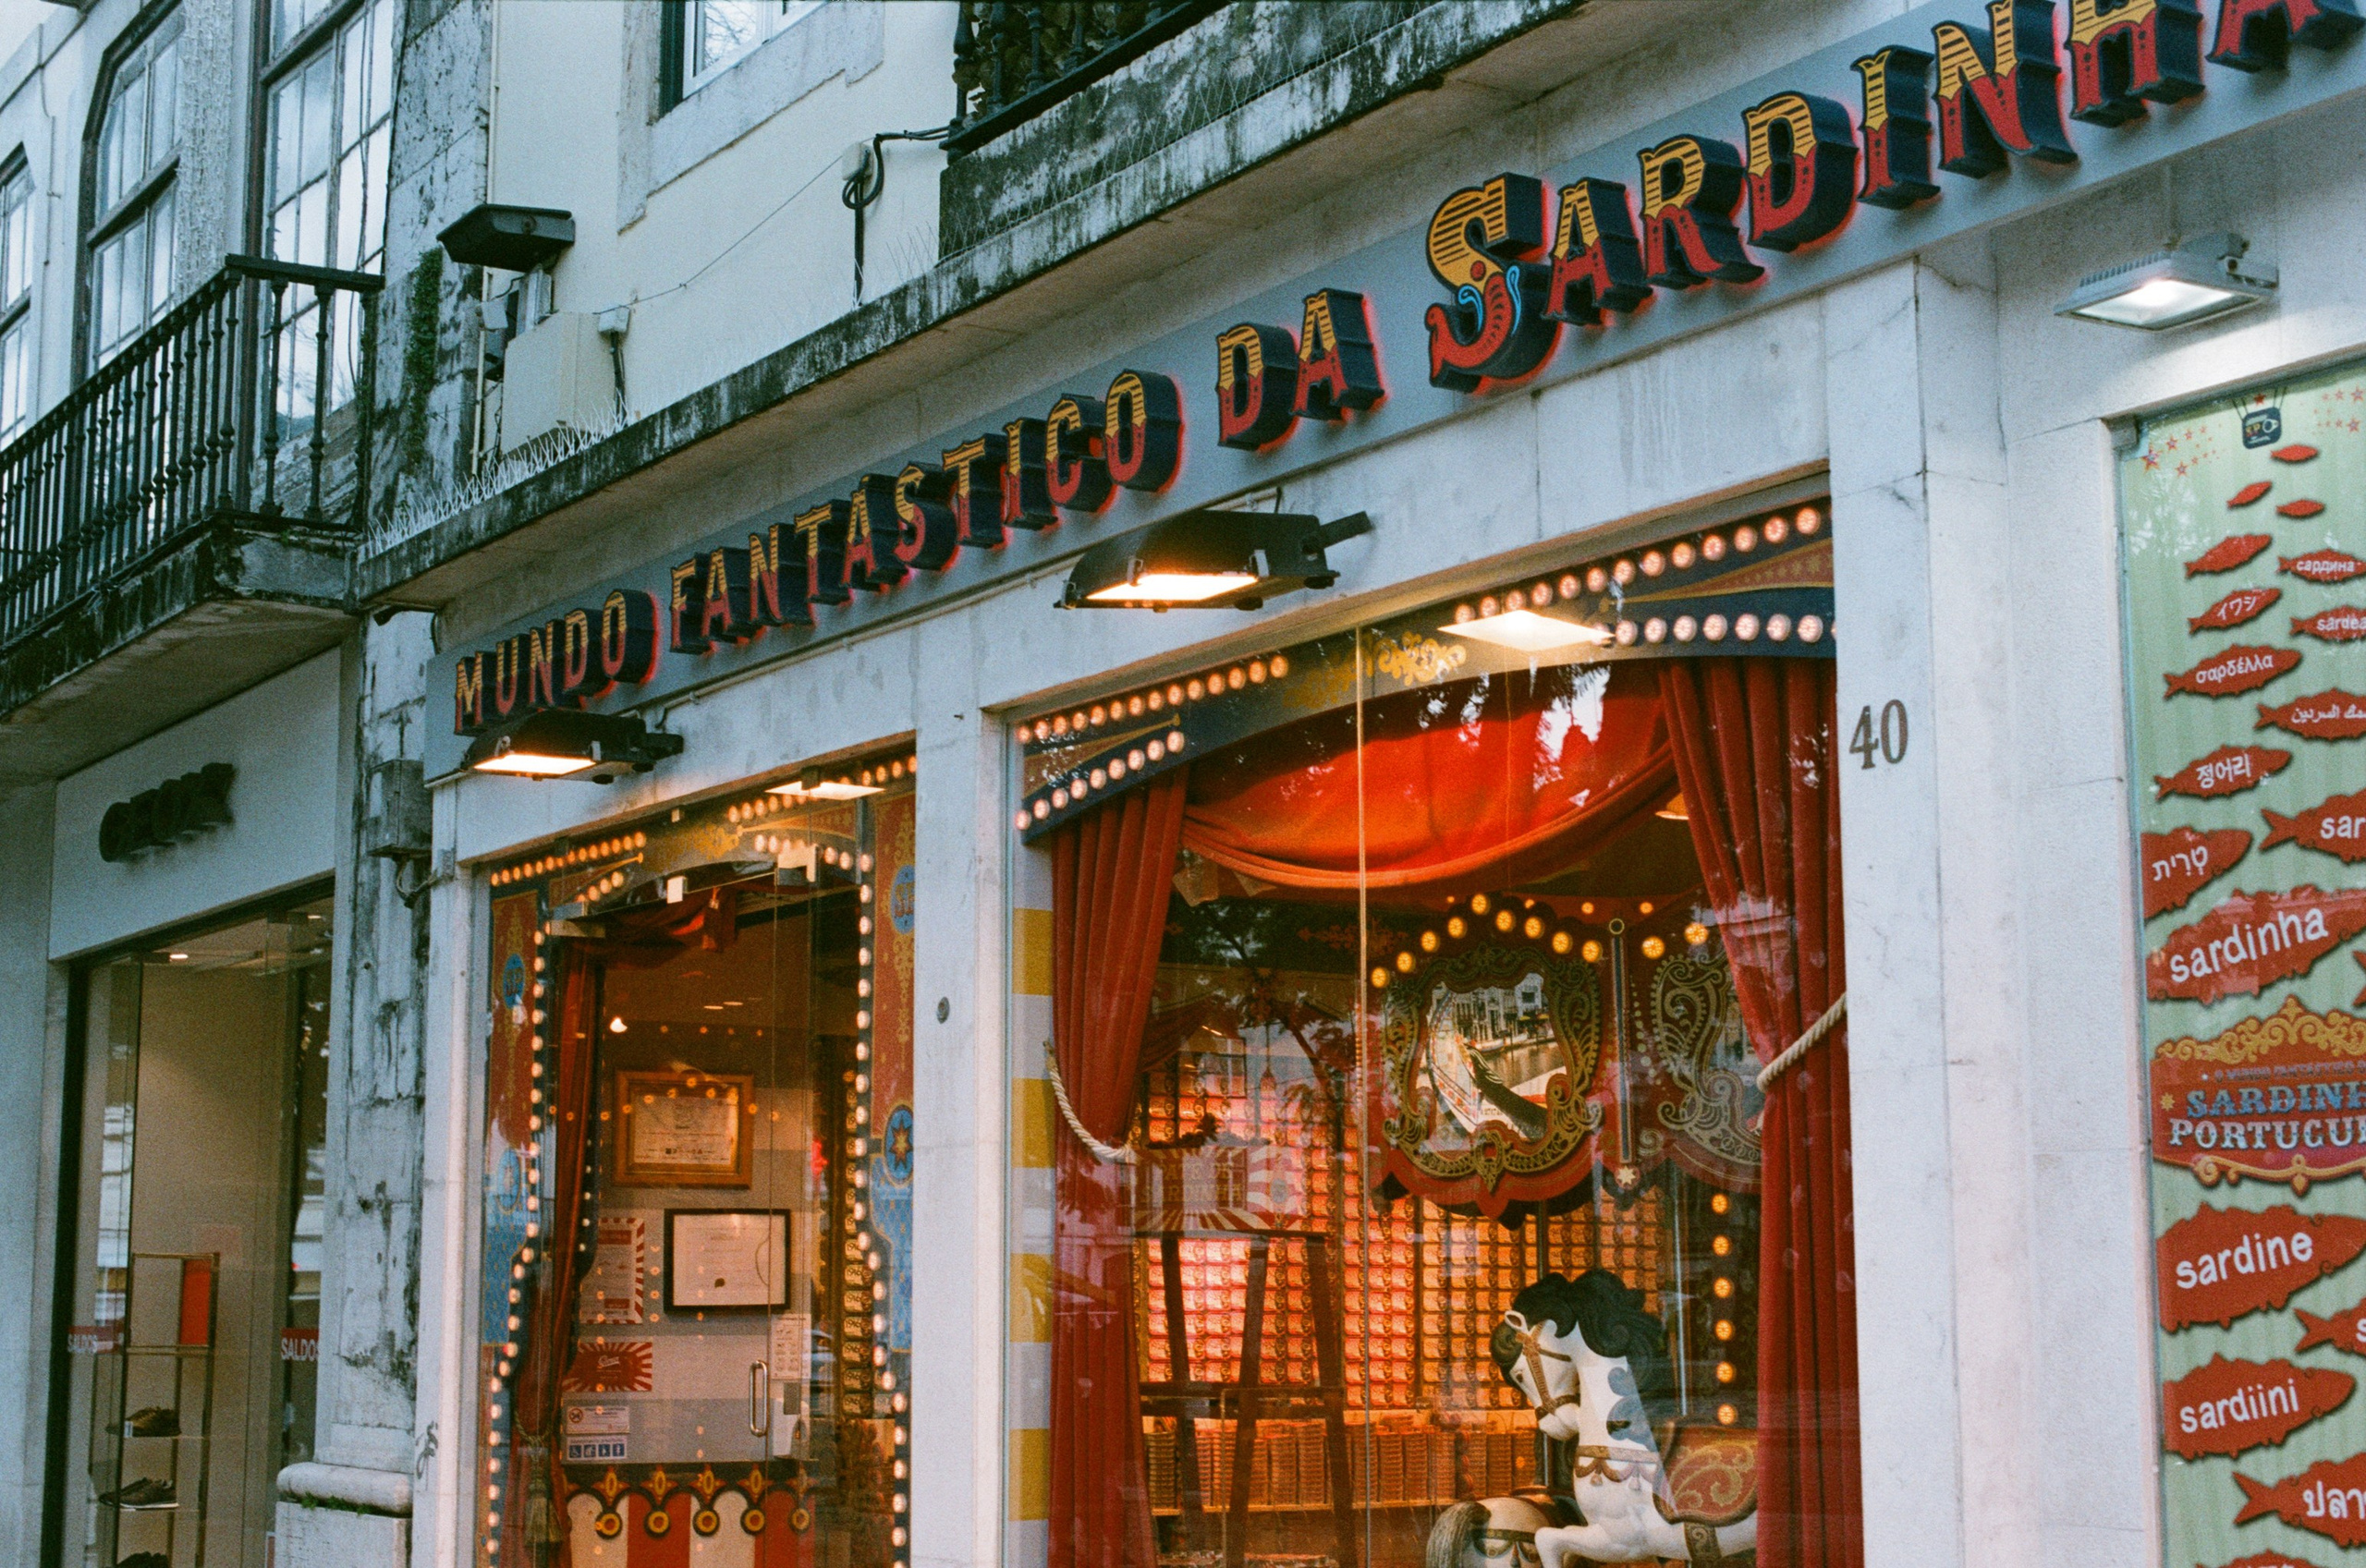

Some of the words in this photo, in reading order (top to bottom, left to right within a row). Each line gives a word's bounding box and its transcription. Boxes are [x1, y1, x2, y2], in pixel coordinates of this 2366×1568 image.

[454, 589, 649, 735] MUNDO
[669, 369, 1172, 652] FANTASTICO
[1215, 287, 1372, 448] DA
[2296, 559, 2355, 575] сардина
[2217, 596, 2257, 621] イワシ
[2195, 653, 2275, 684] σαρδέλλα
[1849, 699, 1909, 770] 40
[2196, 753, 2251, 788] 정어리
[2170, 907, 2328, 982] sardinha
[2176, 1232, 2313, 1289] sardine
[2179, 1378, 2299, 1433] sardiini
[2302, 1479, 2366, 1520] ปลา
